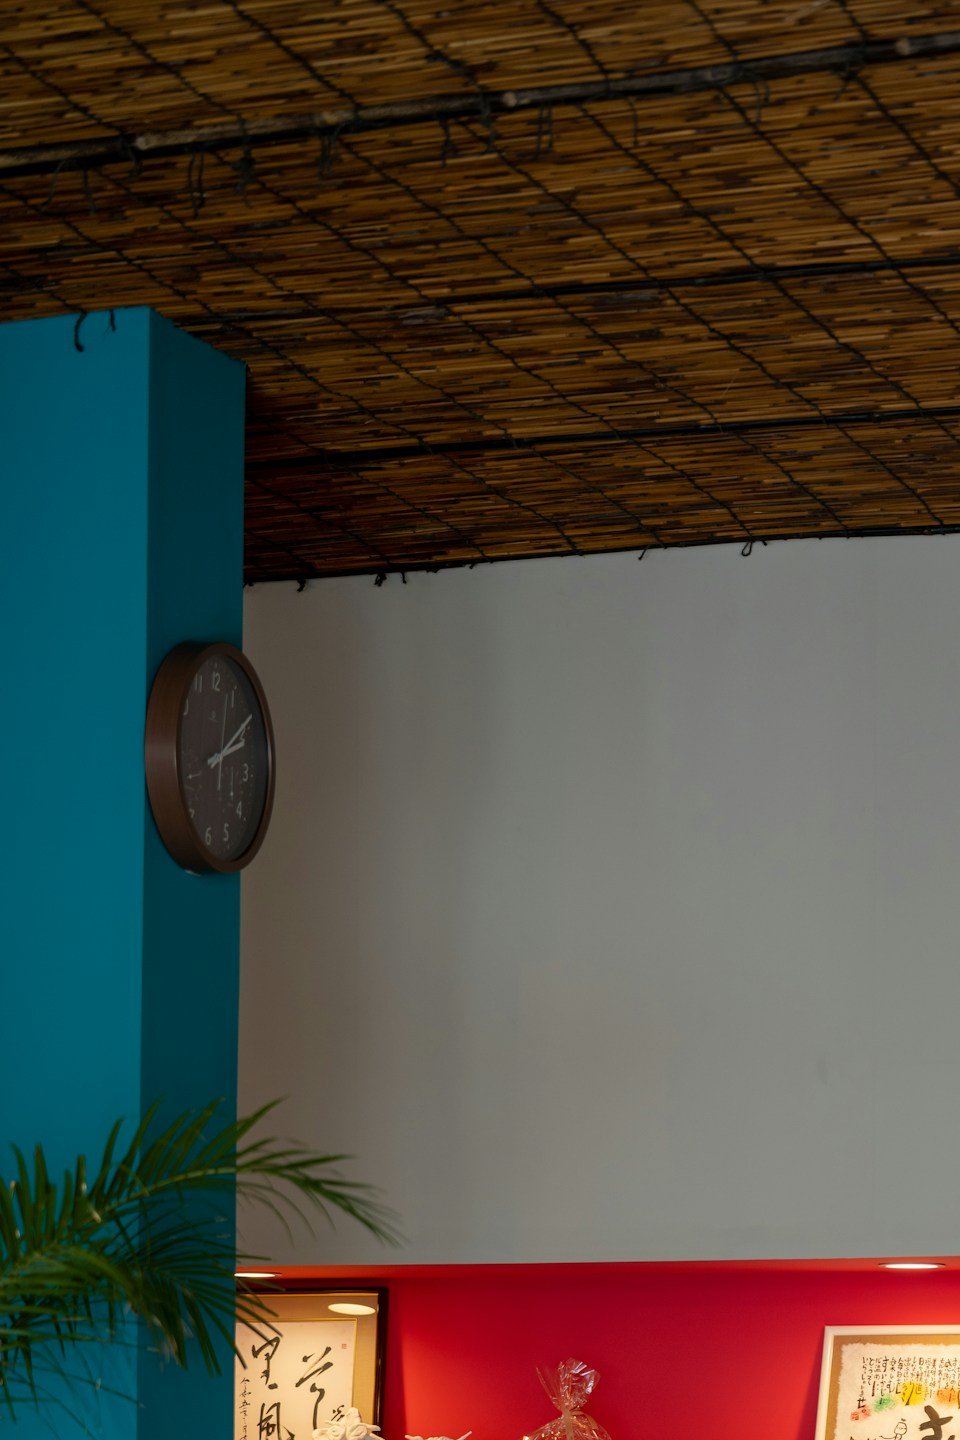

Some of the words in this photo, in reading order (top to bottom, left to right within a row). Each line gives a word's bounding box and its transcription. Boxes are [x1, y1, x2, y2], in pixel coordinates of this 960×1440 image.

[212, 672, 221, 692] 12
[243, 763, 249, 781] 3
[236, 801, 243, 819] 4
[205, 827, 212, 845] 6
[223, 823, 230, 841] 5
